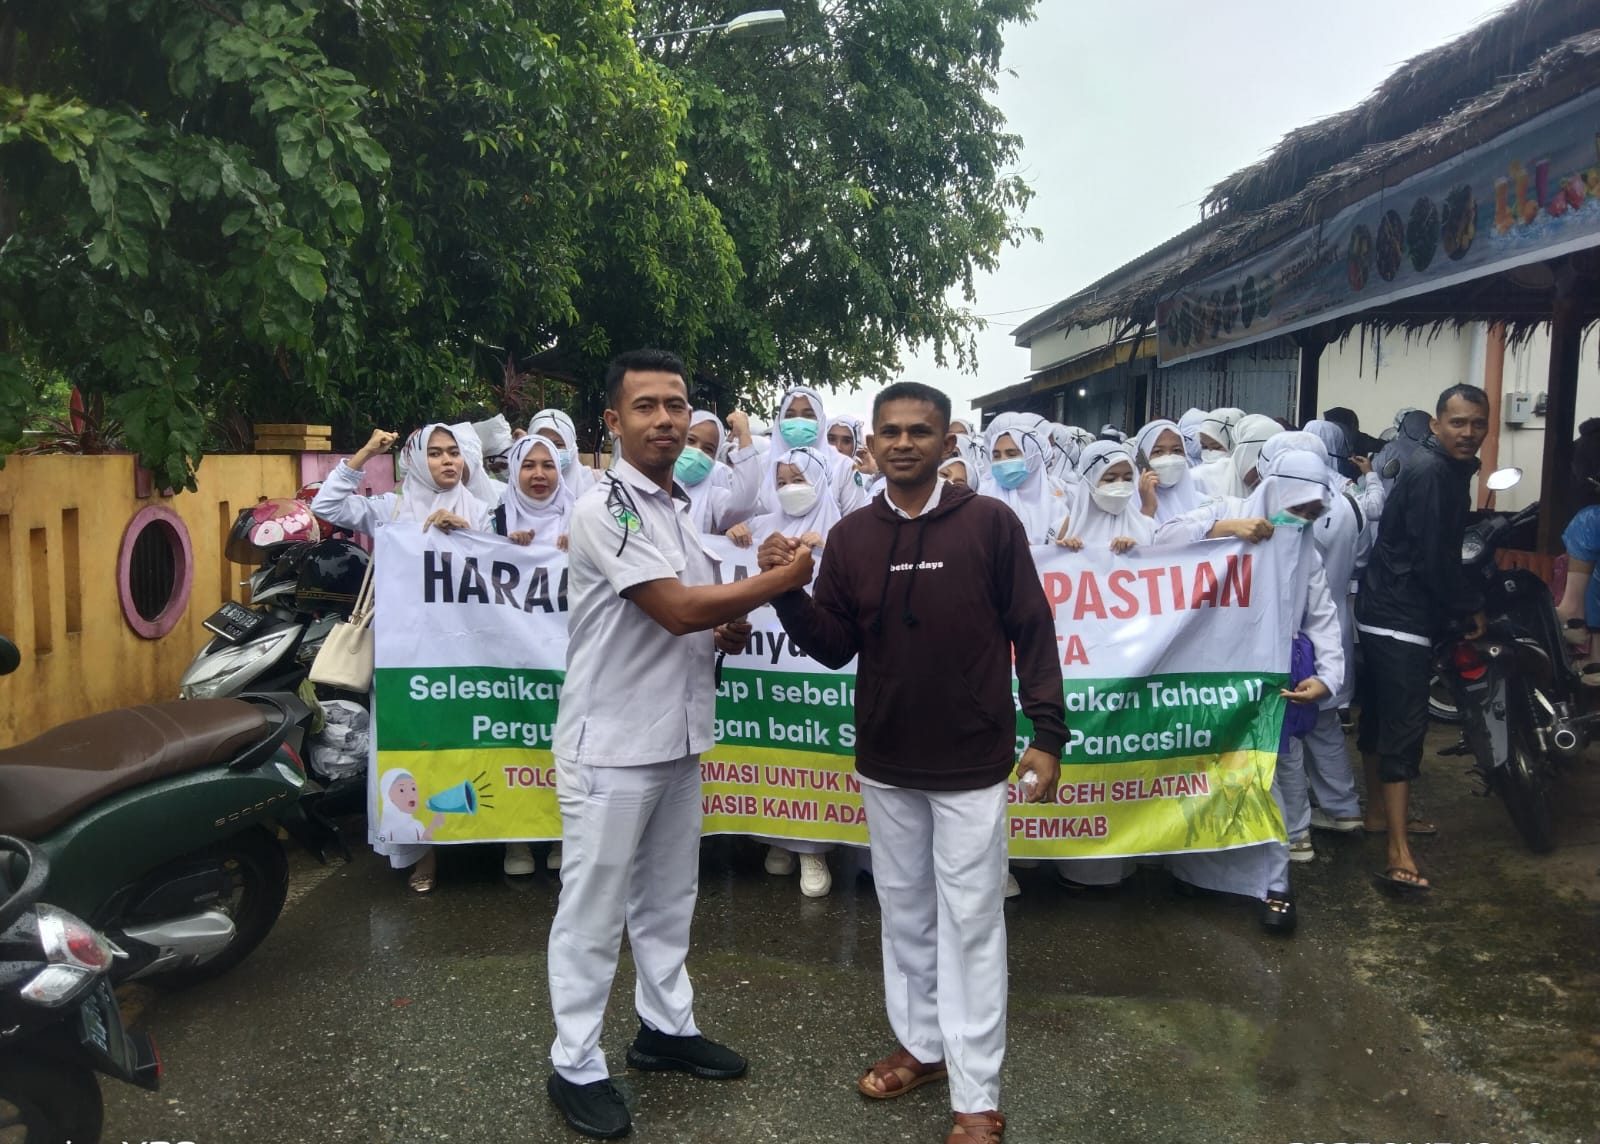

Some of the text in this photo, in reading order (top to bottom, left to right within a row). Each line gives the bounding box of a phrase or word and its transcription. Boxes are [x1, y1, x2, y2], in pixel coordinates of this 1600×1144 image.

[424, 551, 1253, 620] HARA PASTIAN
[1066, 686, 1140, 712] akan
[1147, 680, 1238, 710] Tahap
[473, 715, 555, 746] Pergu
[714, 718, 761, 741] gan
[768, 717, 831, 746] baik
[1065, 723, 1212, 756] Pancasila
[700, 762, 759, 784] RMASI
[765, 766, 840, 792] UNTUK
[1058, 783, 1105, 805] CEH
[1111, 773, 1209, 802] SELATAN
[763, 798, 818, 821] KAMI
[1010, 816, 1108, 839] PEMKAB
